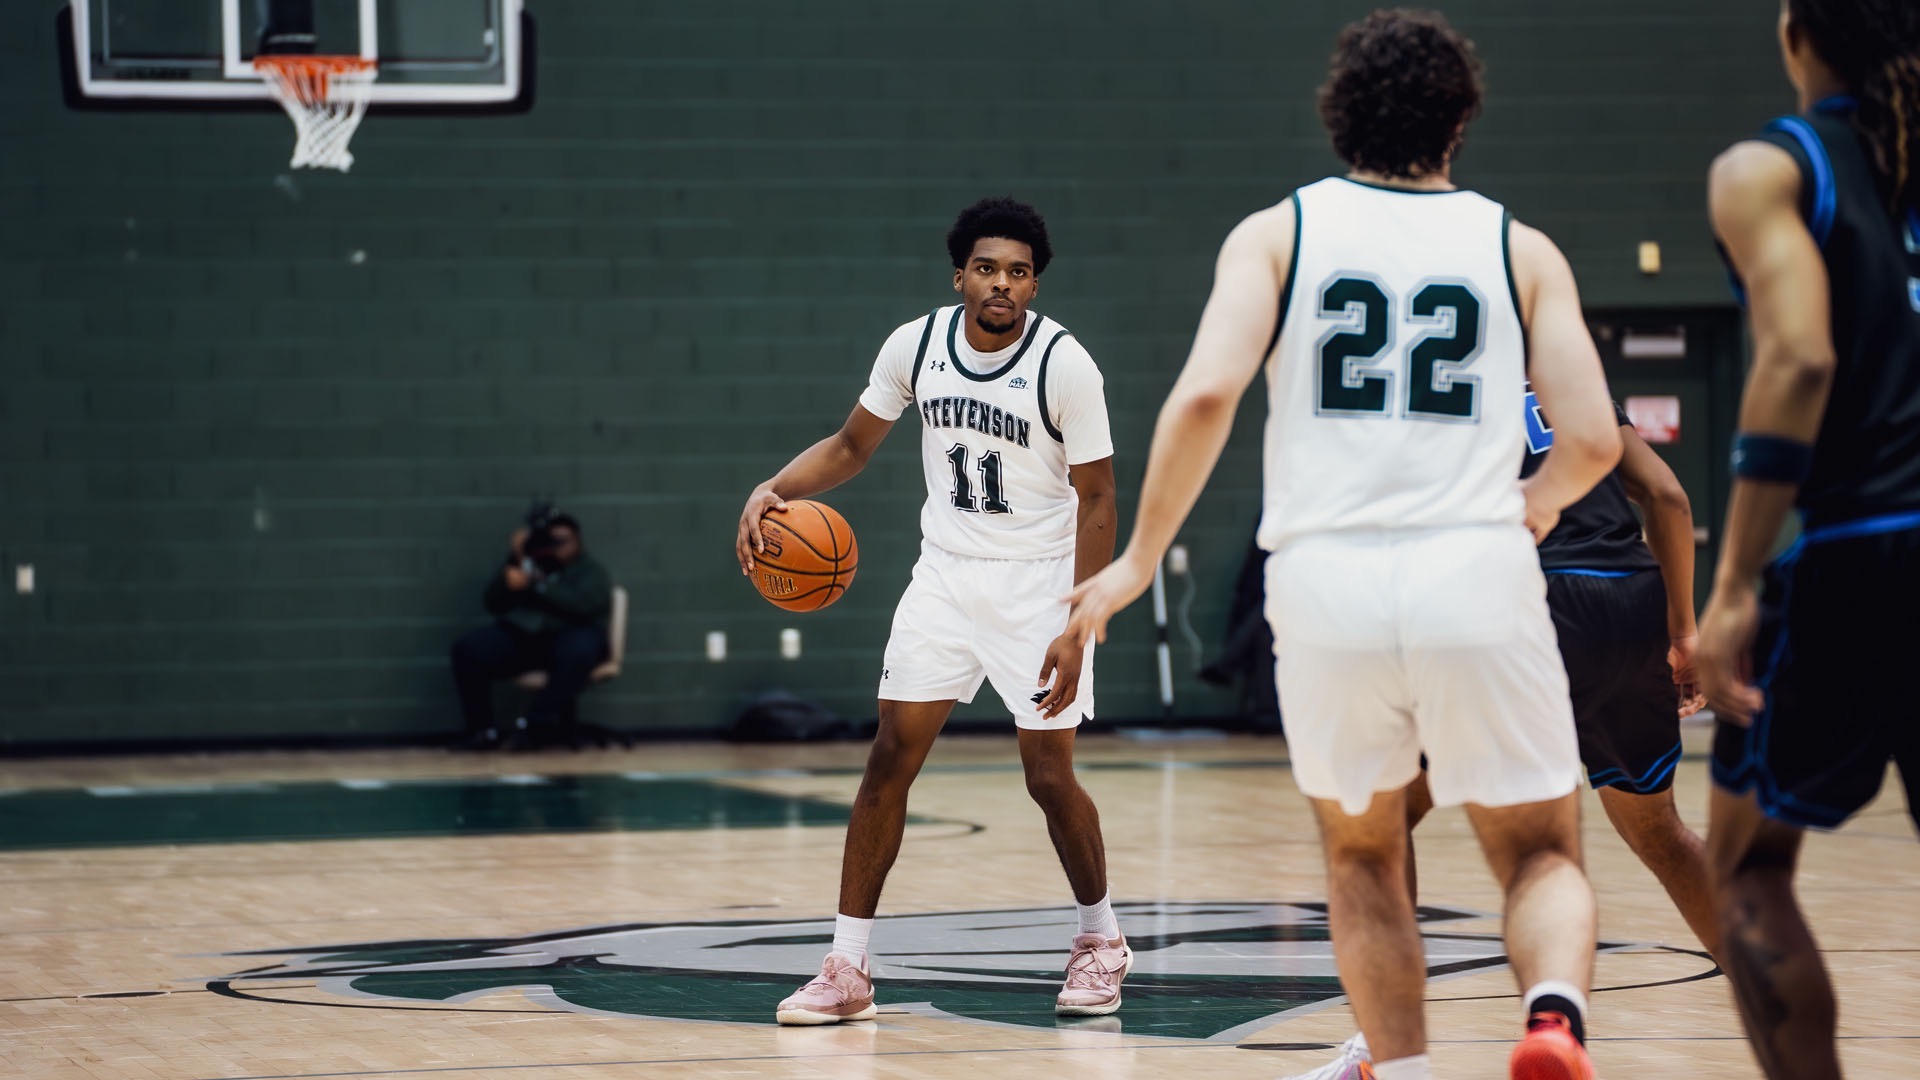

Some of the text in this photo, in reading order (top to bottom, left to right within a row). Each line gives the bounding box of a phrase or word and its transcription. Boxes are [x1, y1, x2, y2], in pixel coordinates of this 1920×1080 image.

[1313, 270, 1488, 425] 22
[922, 396, 1031, 449] STEVENSON
[946, 442, 1013, 514] 11
